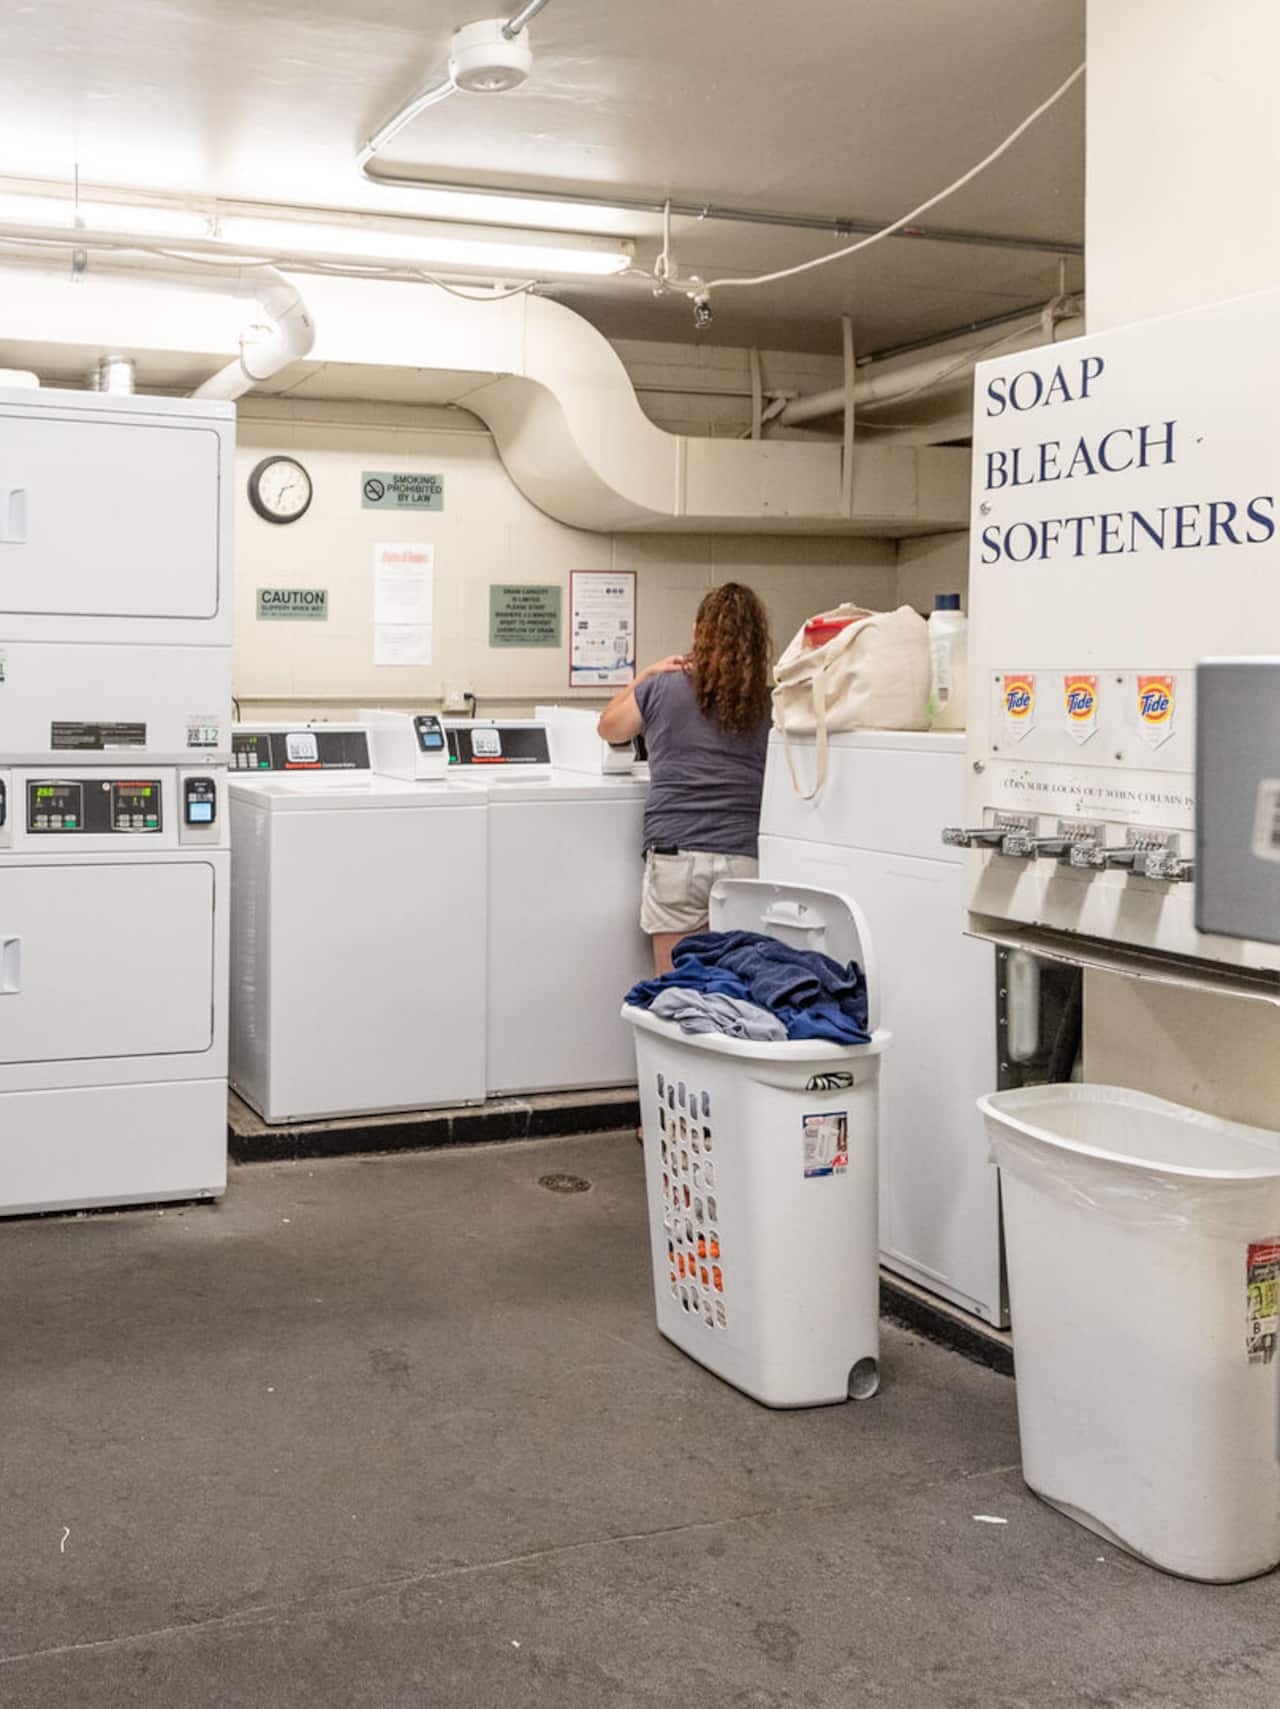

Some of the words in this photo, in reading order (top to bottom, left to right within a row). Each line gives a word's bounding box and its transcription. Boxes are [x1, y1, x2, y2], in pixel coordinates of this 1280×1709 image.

[986, 356, 1105, 417] SOAP
[985, 420, 1178, 490] BLEACH
[387, 484, 442, 494] PROHIBITED
[393, 474, 436, 485] SMOKING
[398, 494, 409, 502] BY
[411, 495, 431, 503] LAW
[981, 496, 1277, 565] SOFTENERS
[261, 590, 325, 604] CAUTION
[1007, 690, 1031, 712] Tide
[1068, 692, 1094, 714] Tide
[1141, 693, 1170, 717] Tide
[203, 728, 219, 741] 12
[1051, 784, 1082, 796] LOCKS
[1083, 787, 1104, 798] OUT
[1105, 788, 1136, 801] WHEN
